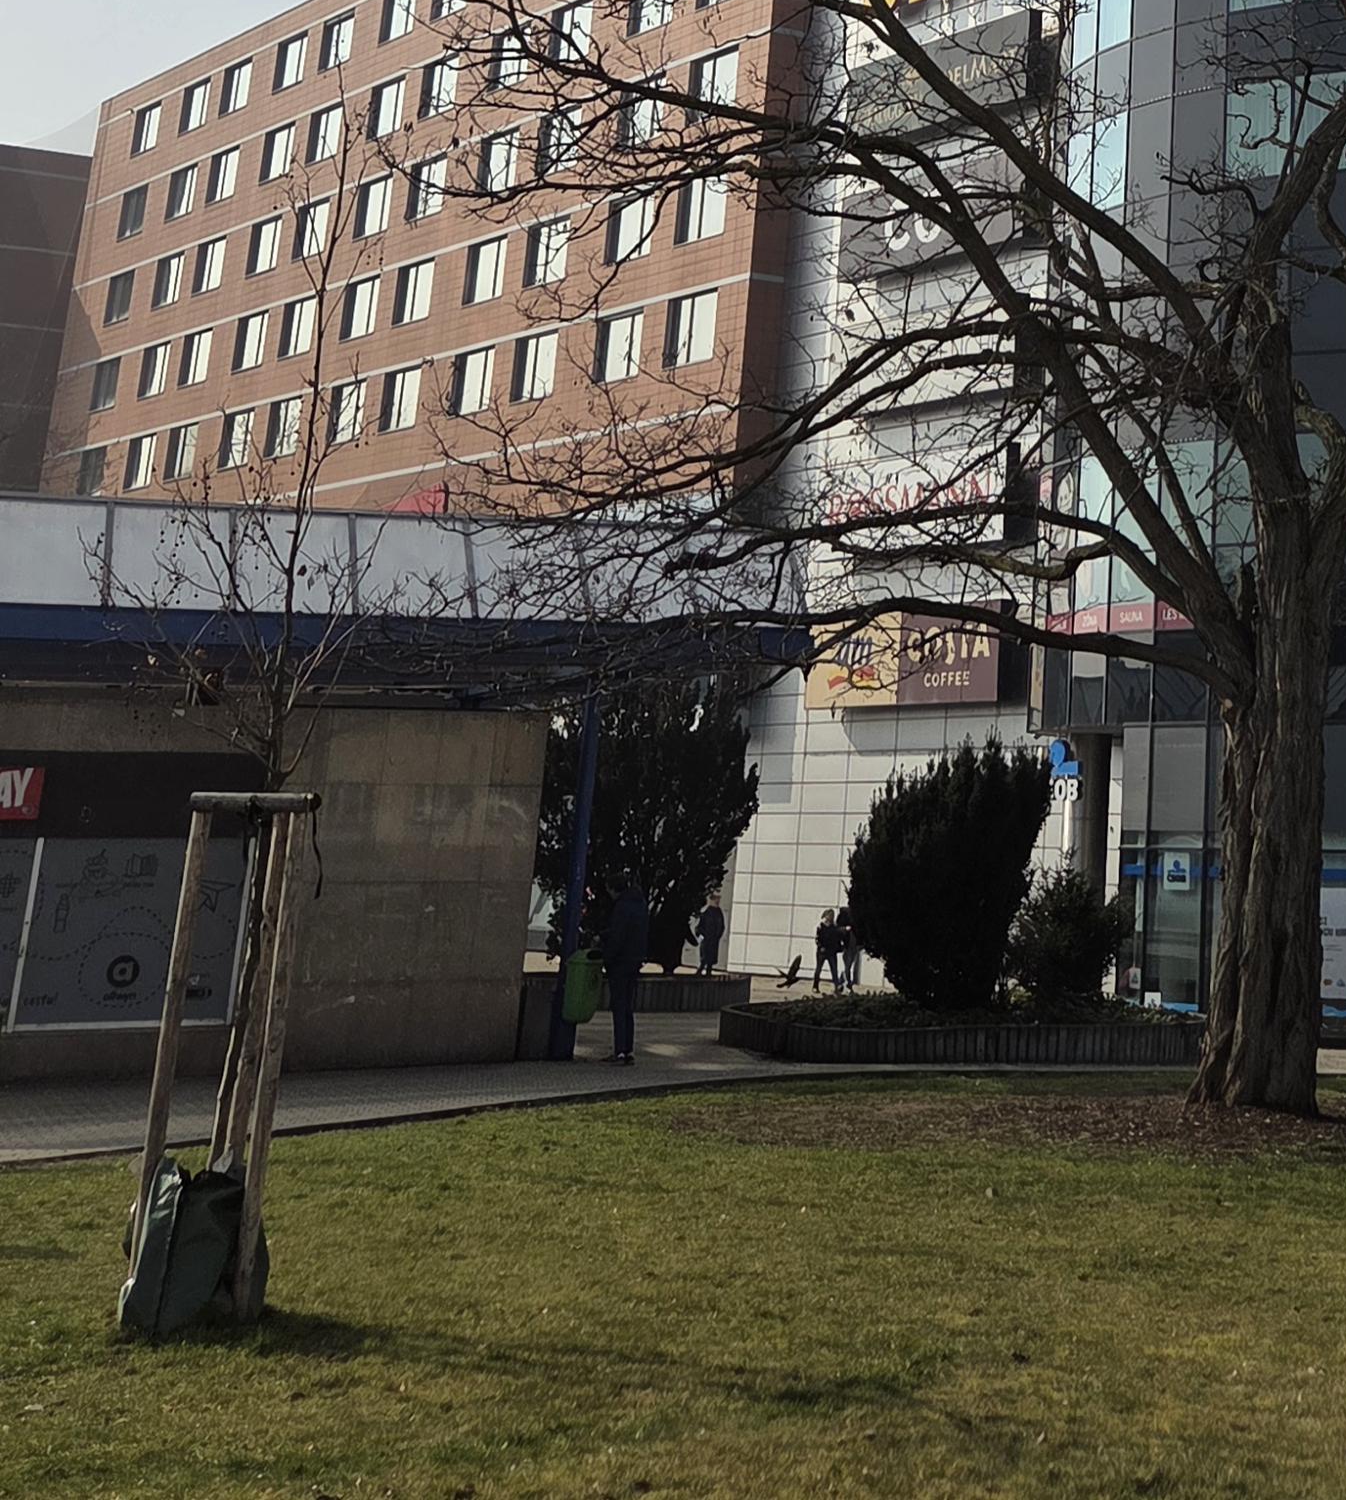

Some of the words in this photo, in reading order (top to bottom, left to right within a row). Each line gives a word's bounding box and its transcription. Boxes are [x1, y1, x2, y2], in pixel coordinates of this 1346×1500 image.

[906, 622, 991, 665] COSTA
[923, 670, 970, 688] COFFEE
[1048, 778, 1079, 801] OB
